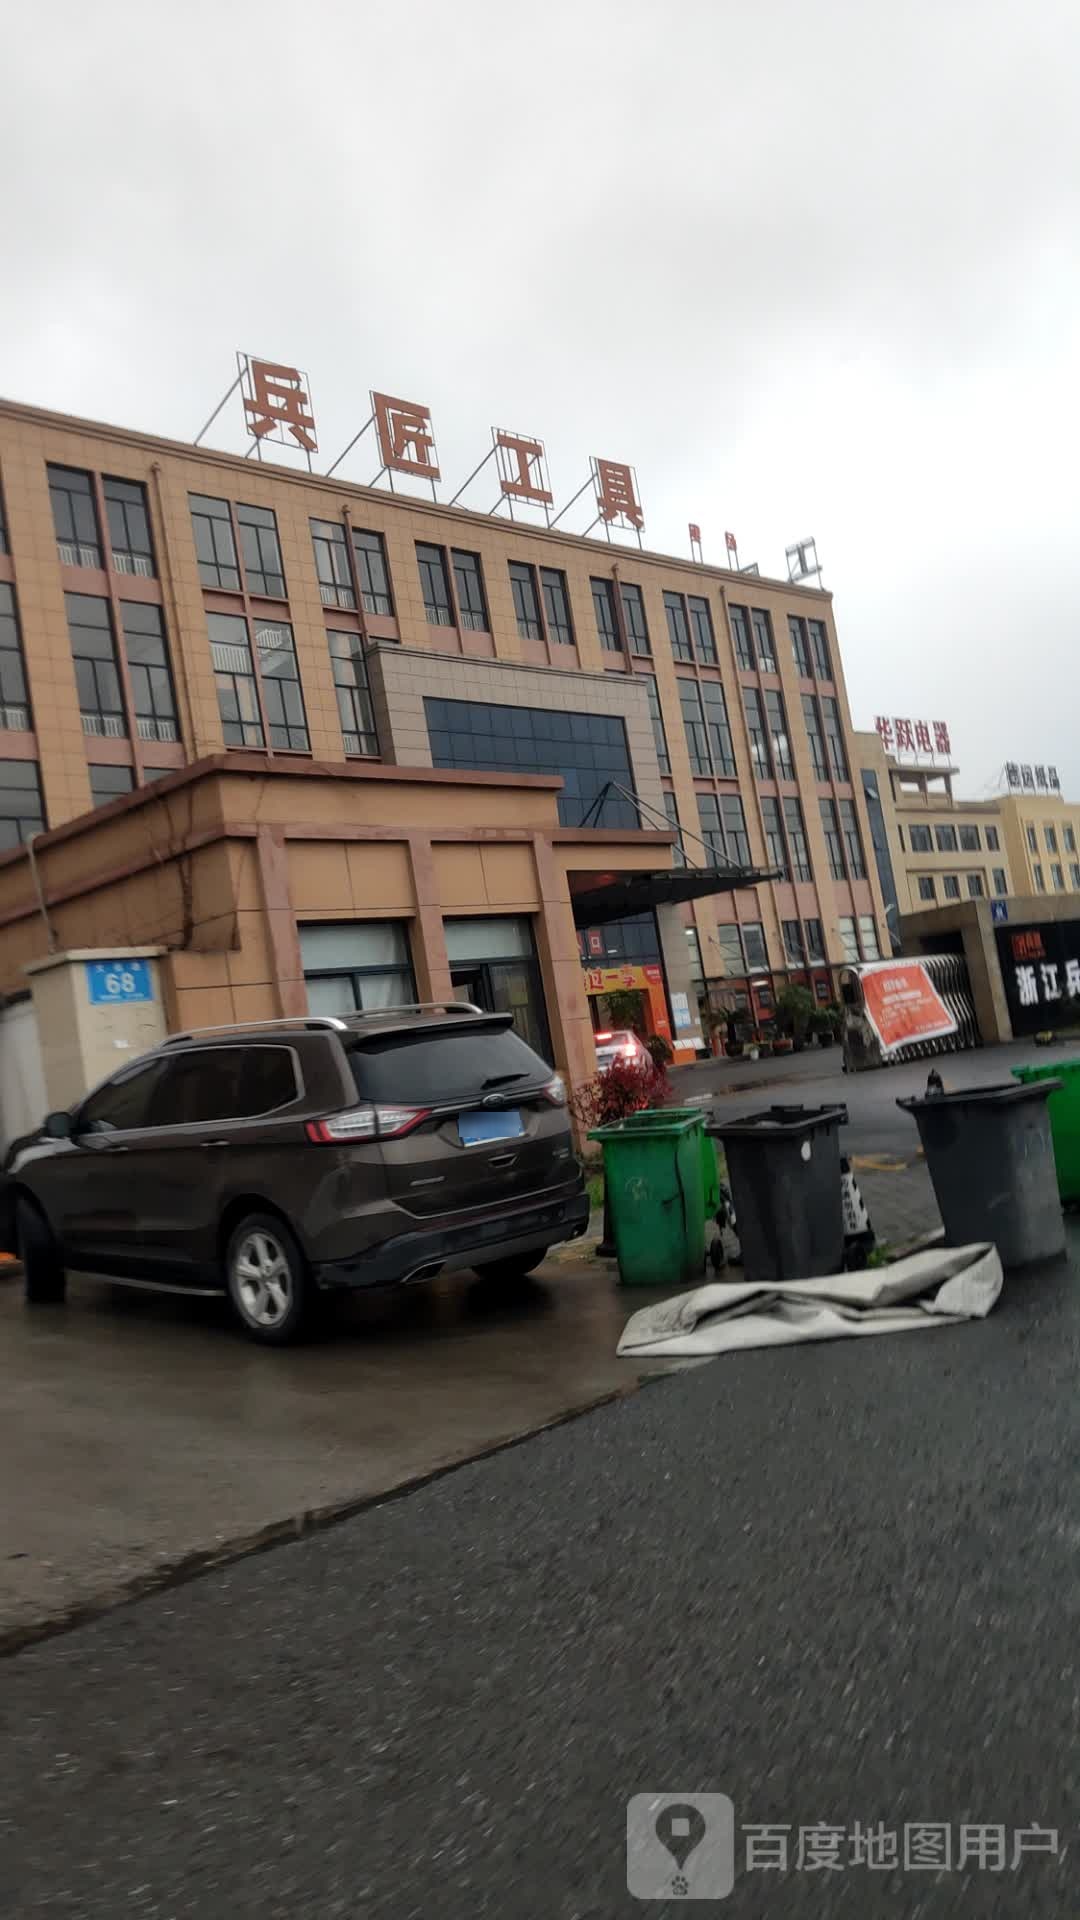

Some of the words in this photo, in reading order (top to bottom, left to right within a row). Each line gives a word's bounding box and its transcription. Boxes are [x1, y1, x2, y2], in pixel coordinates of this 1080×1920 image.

[243, 359, 644, 530] 兵匠工具
[104, 972, 136, 994] 68
